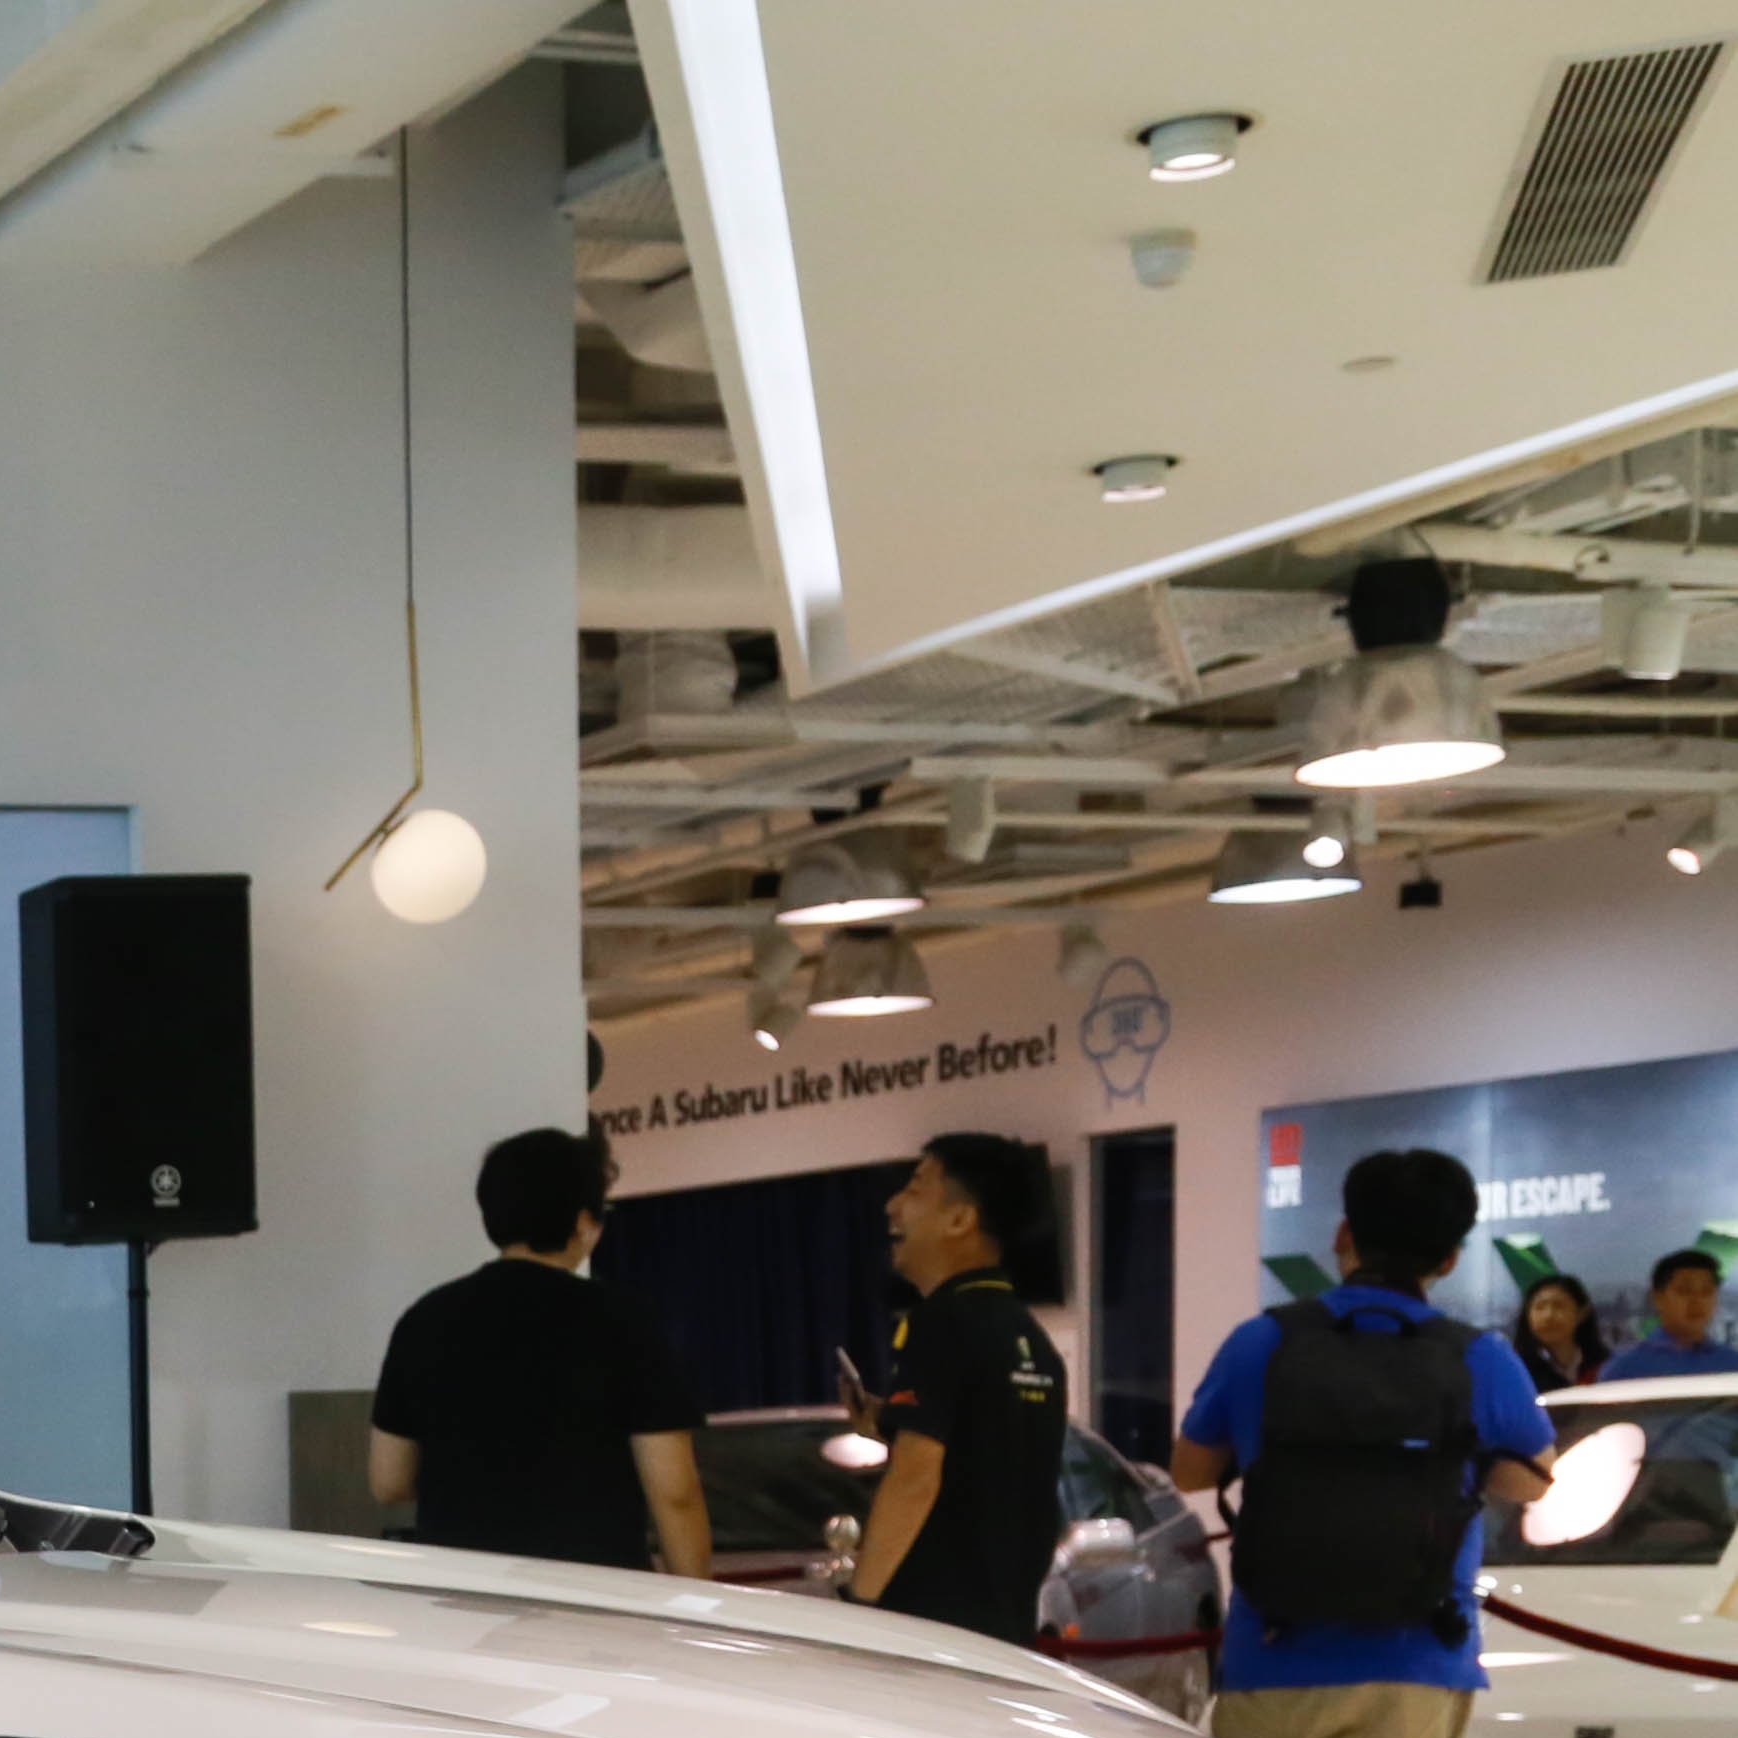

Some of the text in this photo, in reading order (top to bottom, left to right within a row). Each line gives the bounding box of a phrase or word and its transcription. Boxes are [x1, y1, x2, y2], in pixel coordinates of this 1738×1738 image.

[647, 1095, 669, 1130] A
[674, 1082, 768, 1127] Subaru
[776, 1071, 833, 1110] Like
[840, 1056, 932, 1099] Never
[938, 1025, 1058, 1084] Before!
[1510, 1171, 1612, 1219] ESCAPE.
